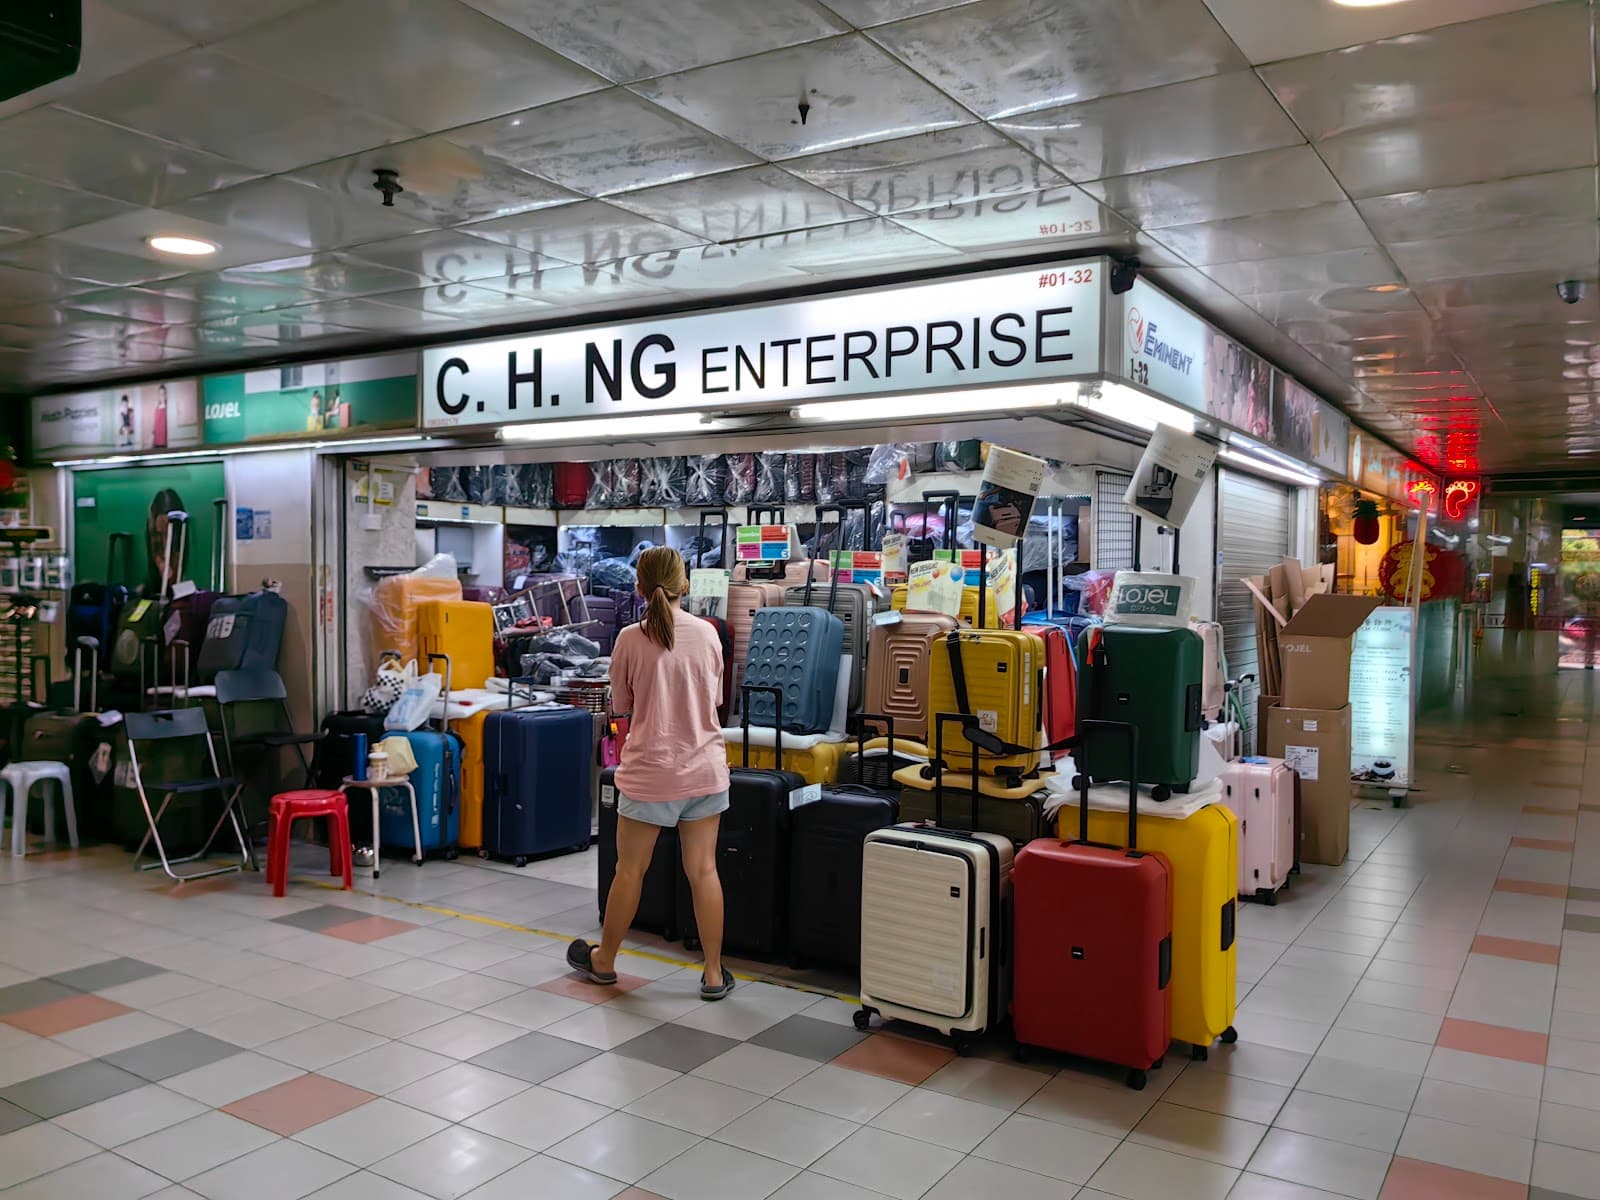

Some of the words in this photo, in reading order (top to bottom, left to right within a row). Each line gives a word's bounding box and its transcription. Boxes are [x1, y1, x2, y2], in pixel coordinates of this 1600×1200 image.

[1038, 268, 1093, 290] #01-32
[436, 357, 485, 416] C.
[508, 349, 560, 409] H.
[585, 333, 677, 404] NG
[702, 306, 1075, 394] ENTERPRISE
[1144, 321, 1193, 376] EMINENT
[1130, 358, 1149, 385] 1-32
